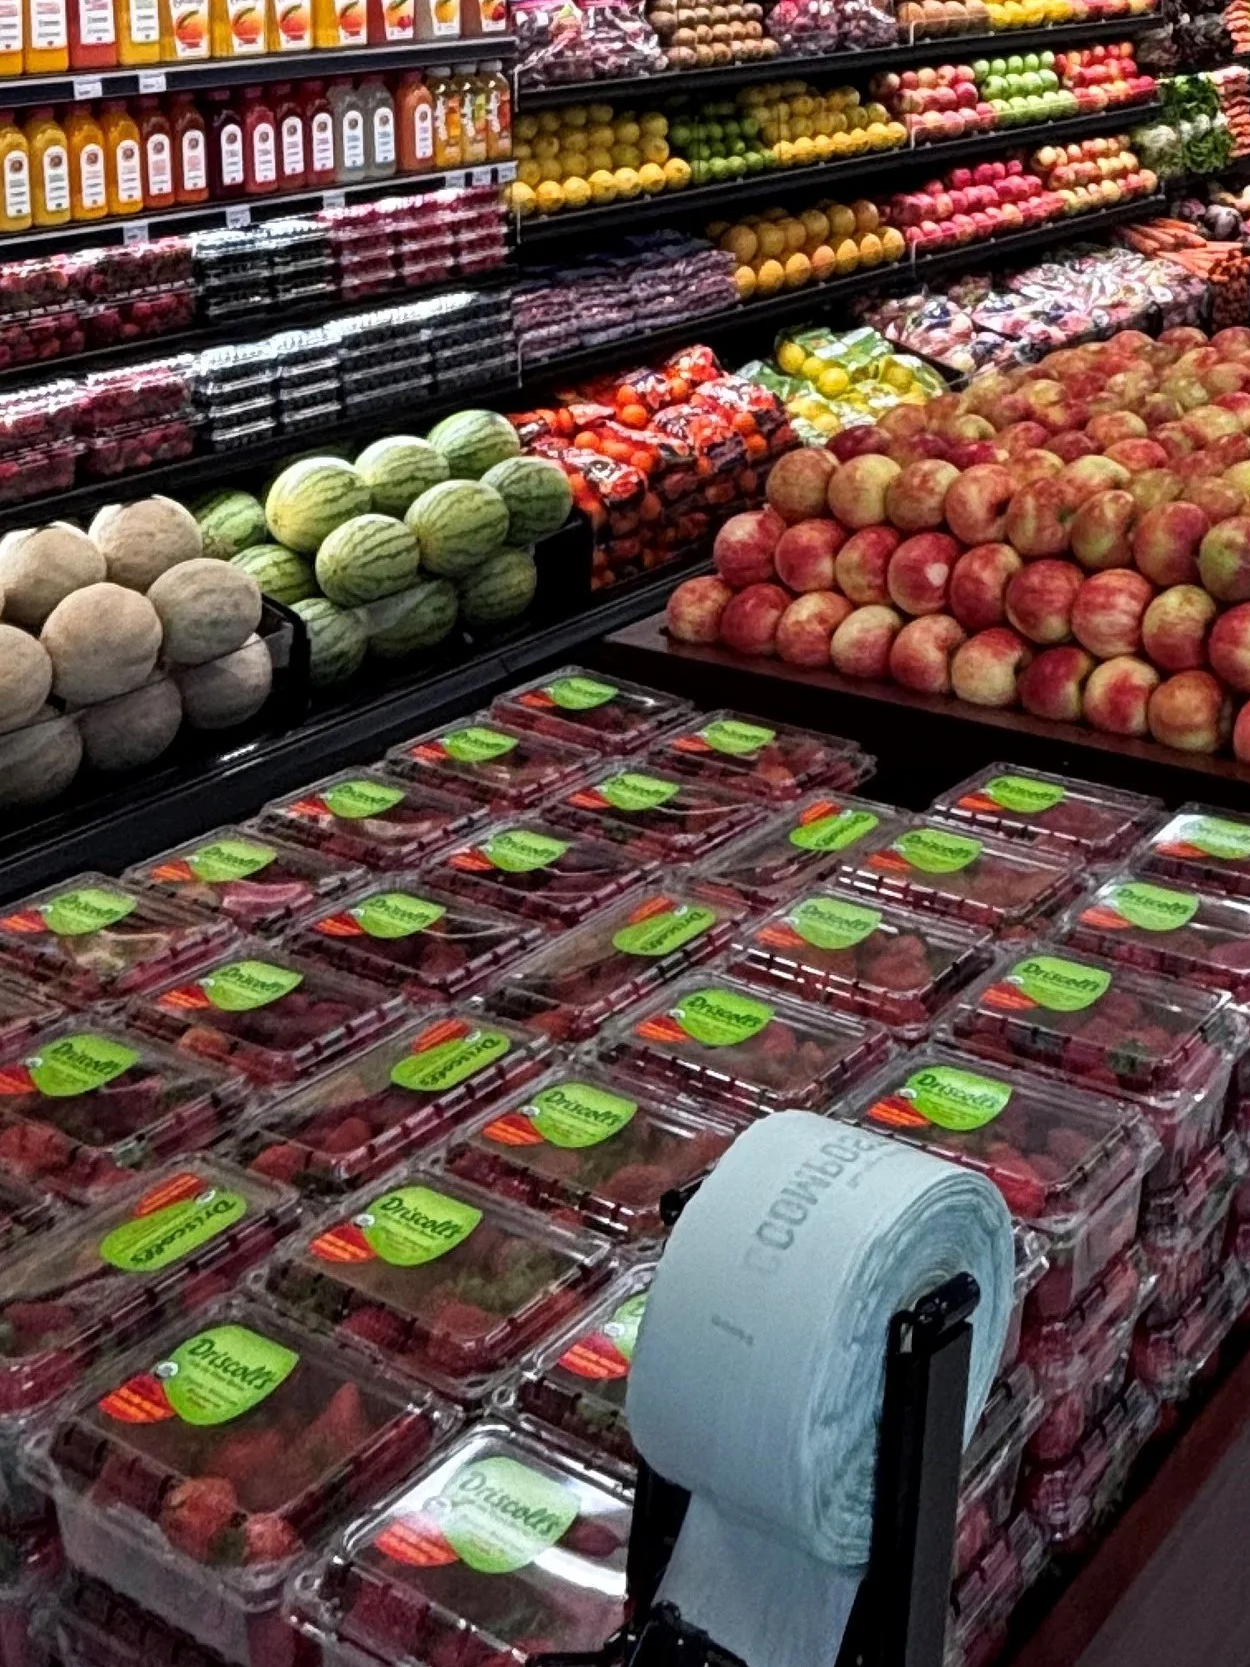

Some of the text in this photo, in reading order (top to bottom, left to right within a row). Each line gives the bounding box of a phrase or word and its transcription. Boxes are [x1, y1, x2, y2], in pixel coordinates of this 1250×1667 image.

[1022, 962, 1101, 993] Driscoll's
[684, 995, 762, 1029] Driscoll's
[545, 1090, 623, 1127] Driscoll's
[917, 1073, 997, 1109] Driscoll's
[130, 1199, 237, 1263] Driscoll's
[379, 1196, 464, 1240] Driscoll's
[187, 1337, 276, 1391] Driscoll's
[458, 1470, 561, 1537] Driscoll's
